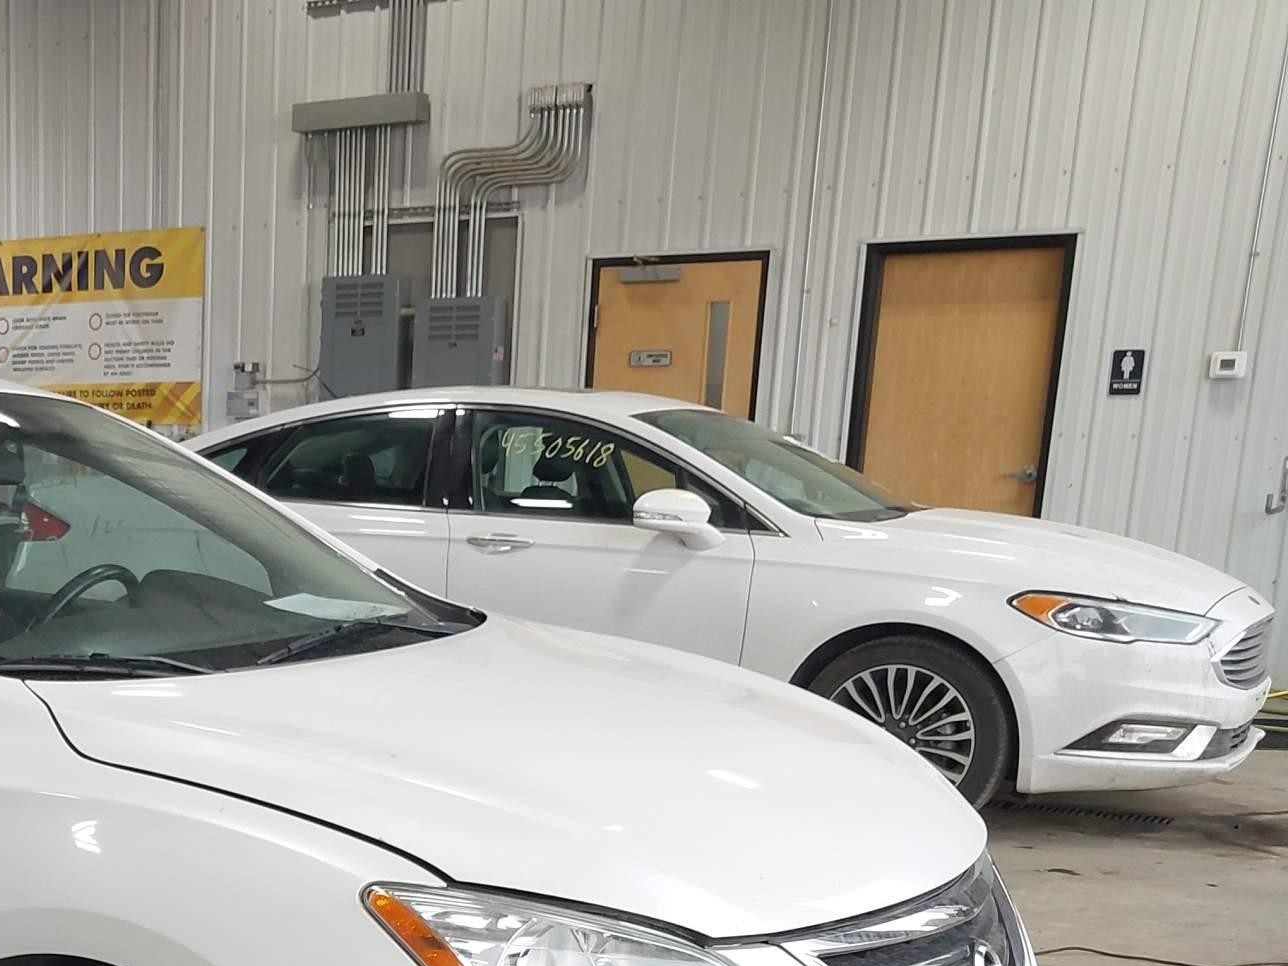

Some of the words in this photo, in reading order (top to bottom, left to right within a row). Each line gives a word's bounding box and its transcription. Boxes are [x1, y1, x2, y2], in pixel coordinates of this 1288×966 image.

[91, 389, 123, 398] FOLLOW
[125, 388, 156, 397] POSTED
[502, 425, 615, 468] 45505618
